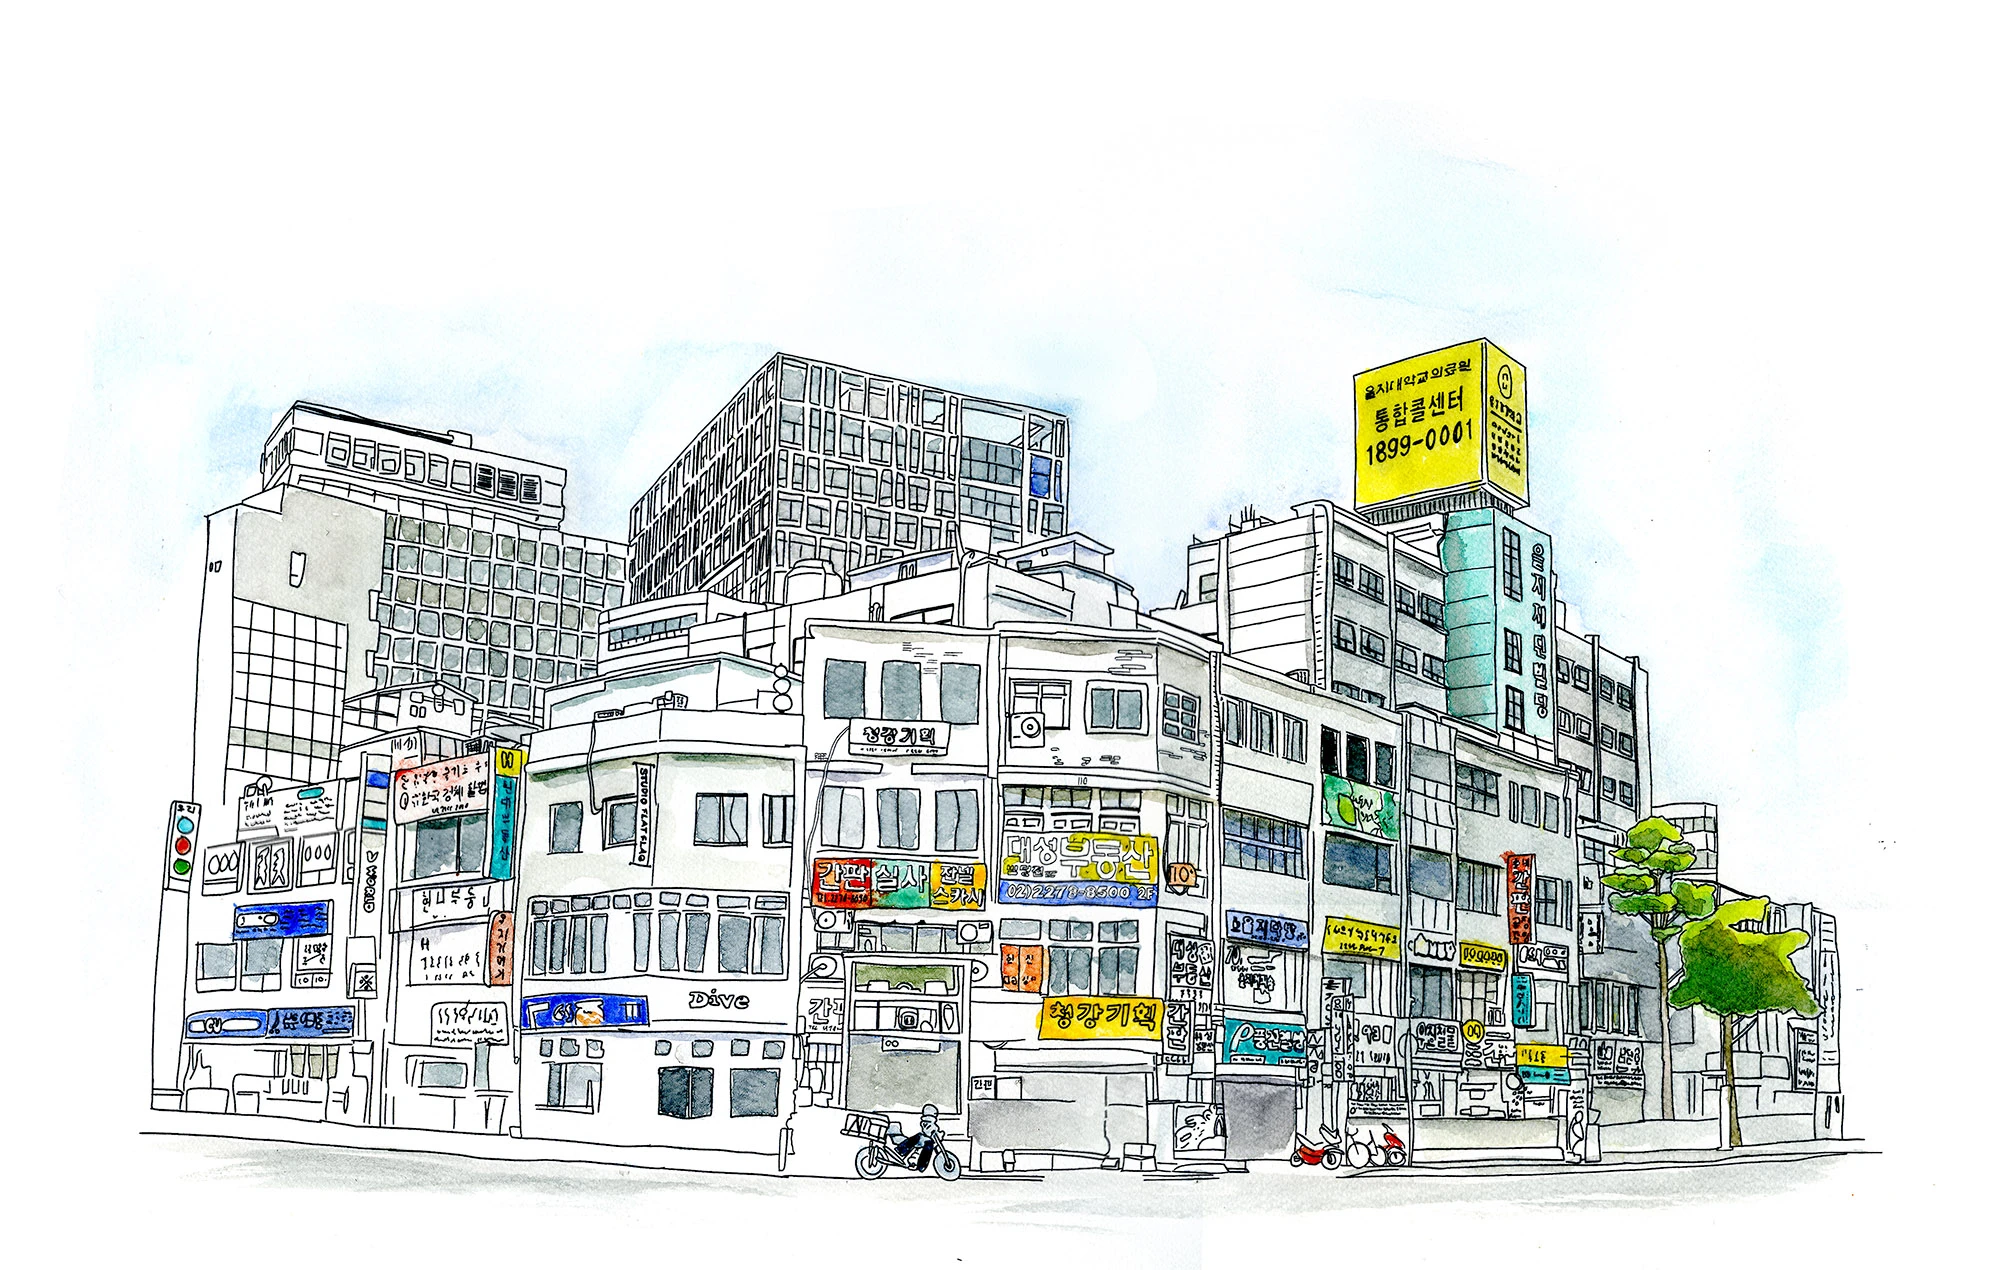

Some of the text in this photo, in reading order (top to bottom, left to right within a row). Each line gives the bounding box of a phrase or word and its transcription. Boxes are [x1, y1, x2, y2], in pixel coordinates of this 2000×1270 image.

[1375, 385, 1464, 433] 통합콜센터
[1366, 418, 1472, 466] 1899-0001
[638, 767, 648, 806] STUDIO
[640, 807, 648, 834] FLAT
[363, 865, 378, 914] WORLD
[818, 862, 927, 893] 간판 실사
[933, 886, 984, 907] 스카시
[1137, 887, 1154, 900] 2F
[689, 988, 750, 1009] Dive
[205, 1018, 222, 1034] CU
[1050, 1001, 1157, 1031] 청강기획
